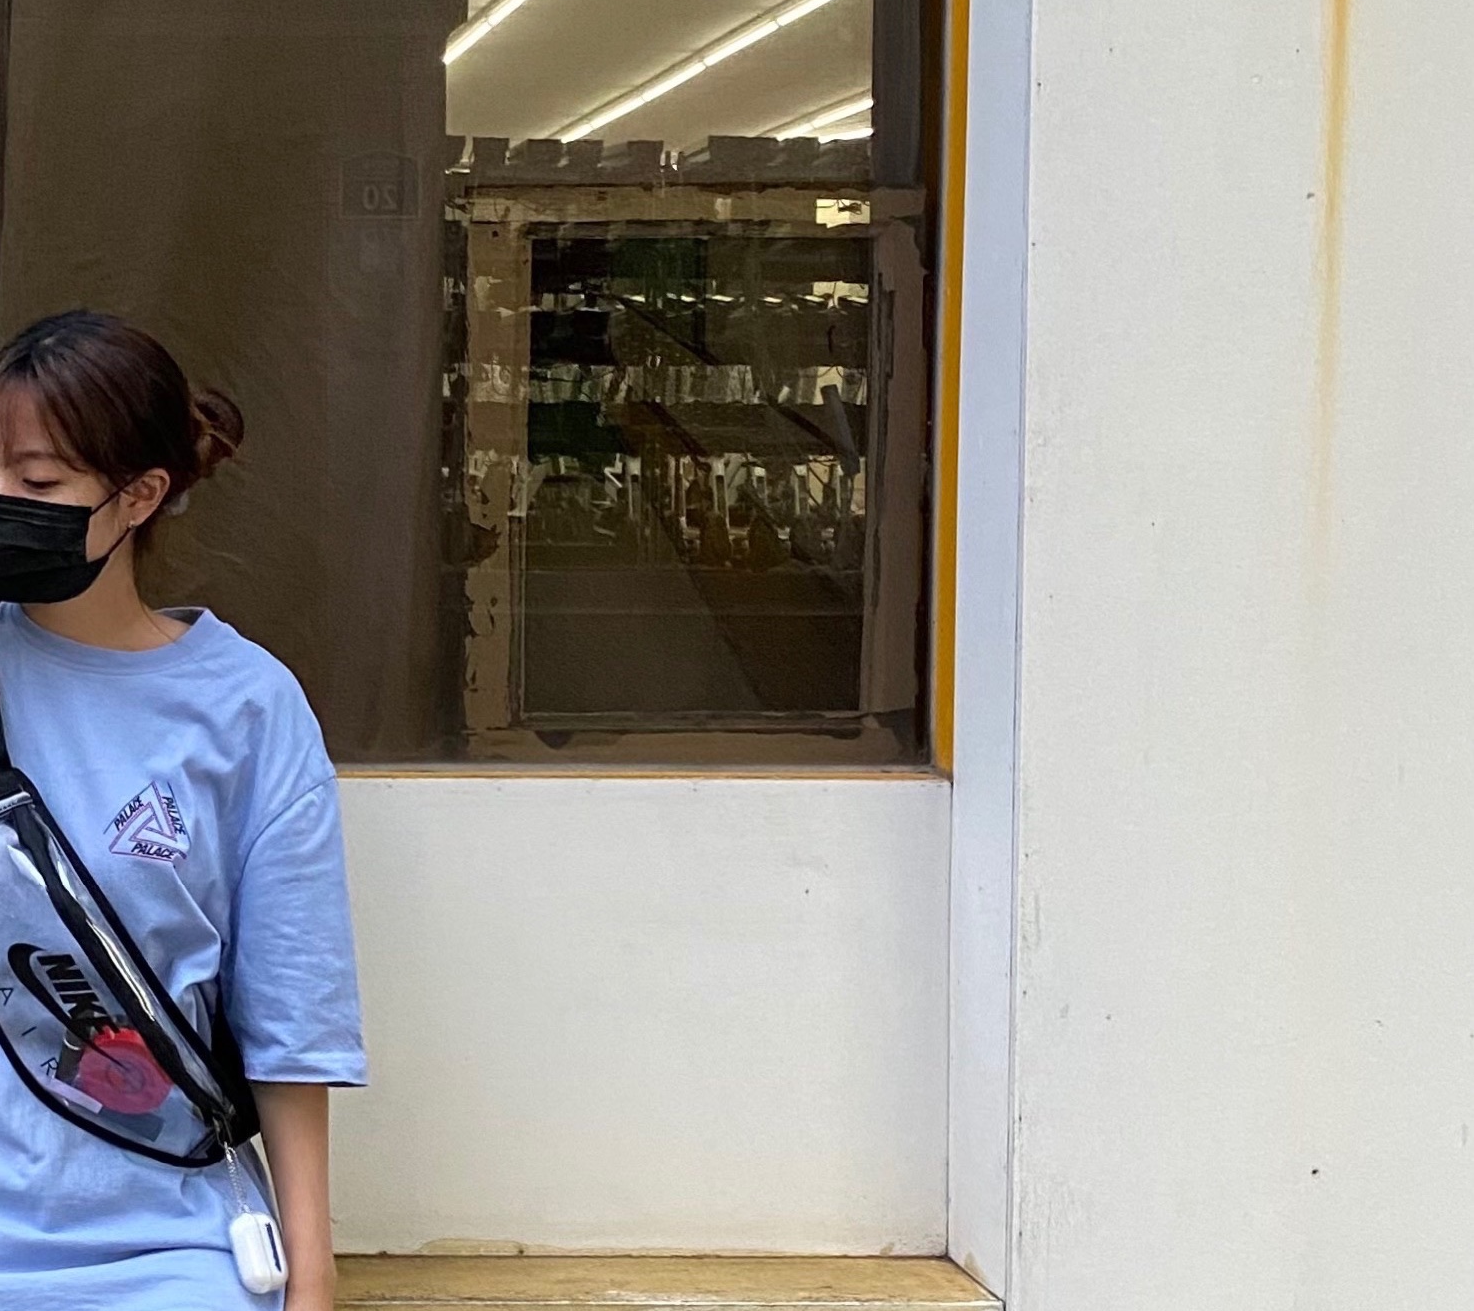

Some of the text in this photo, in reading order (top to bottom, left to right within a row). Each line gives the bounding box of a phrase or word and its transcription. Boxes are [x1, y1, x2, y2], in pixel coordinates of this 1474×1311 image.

[113, 795, 144, 832] PALACE
[161, 795, 187, 836] PALACE
[130, 842, 176, 860] PALACE
[36, 953, 121, 1035] NIKE
